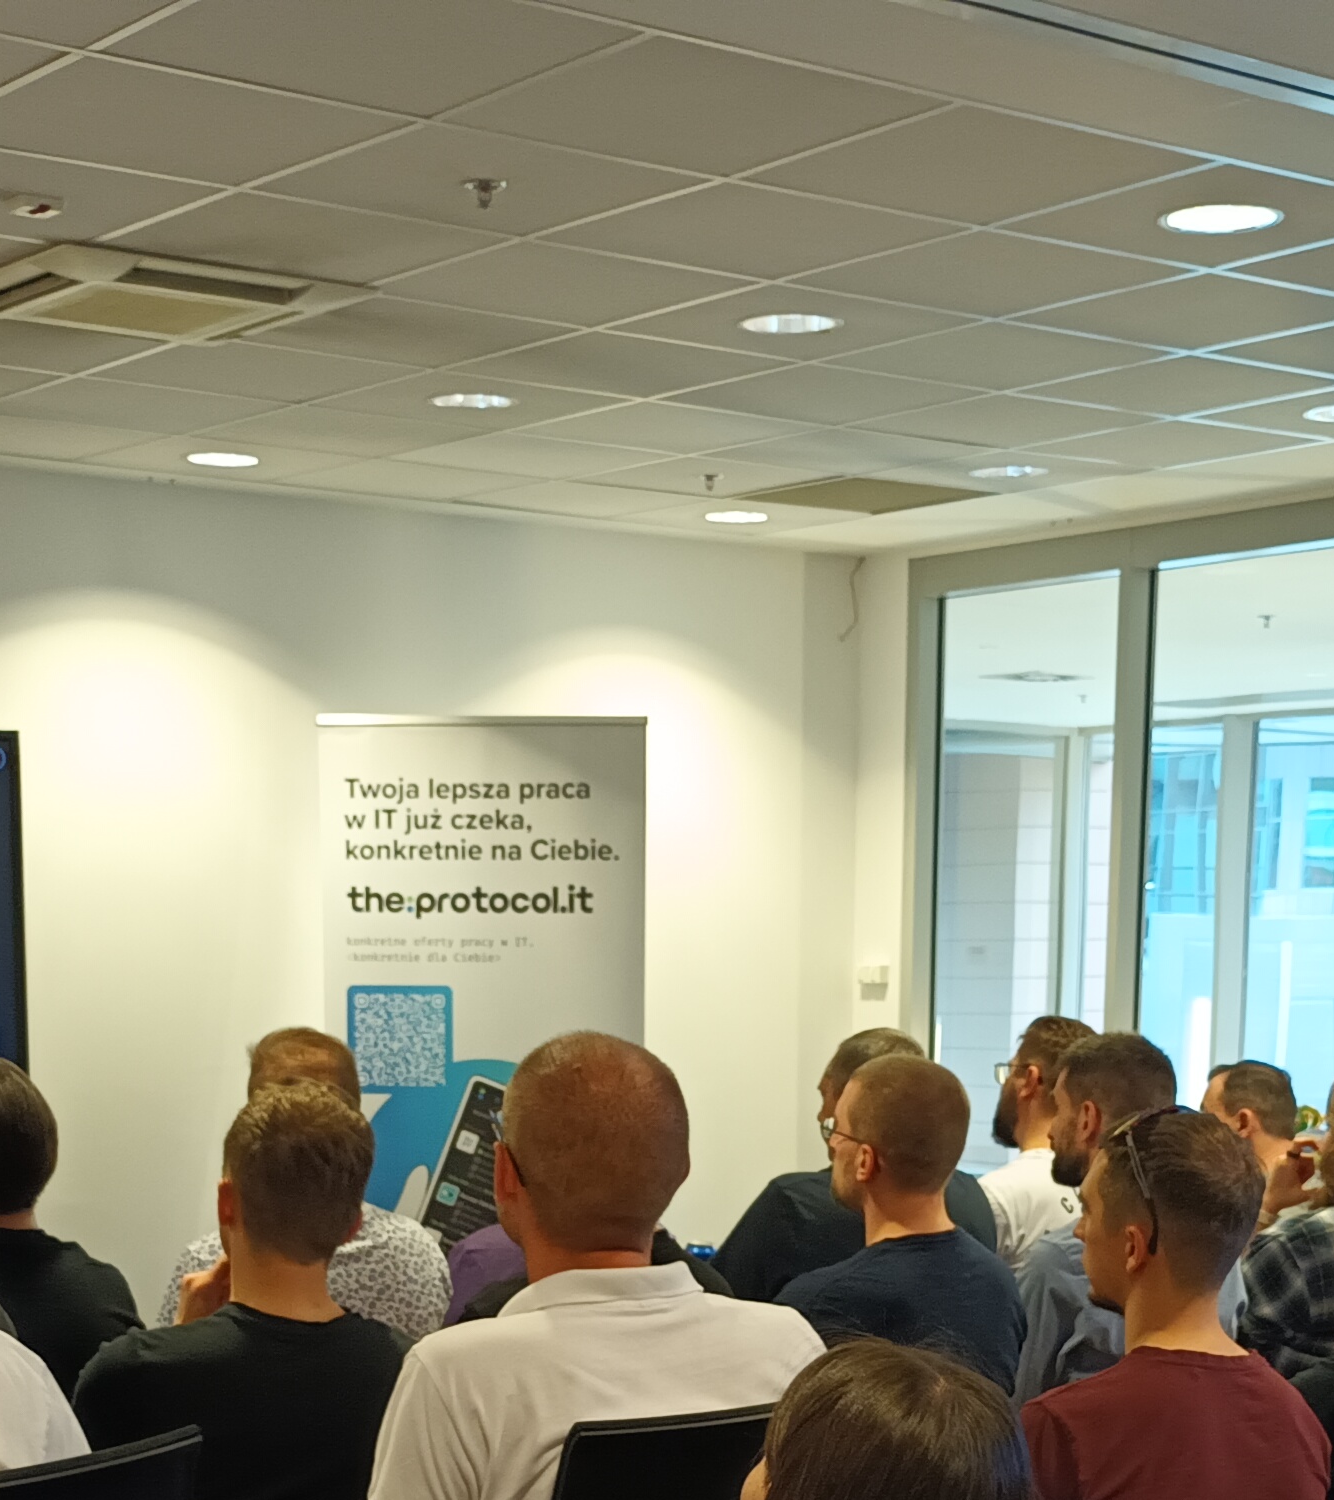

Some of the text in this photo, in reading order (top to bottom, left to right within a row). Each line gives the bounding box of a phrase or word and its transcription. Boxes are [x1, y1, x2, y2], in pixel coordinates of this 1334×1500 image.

[344, 778, 591, 805] Twoja lepsza praca
[344, 808, 533, 835] w IT już czeka,
[345, 838, 620, 862] konkretnie na Ciebie.
